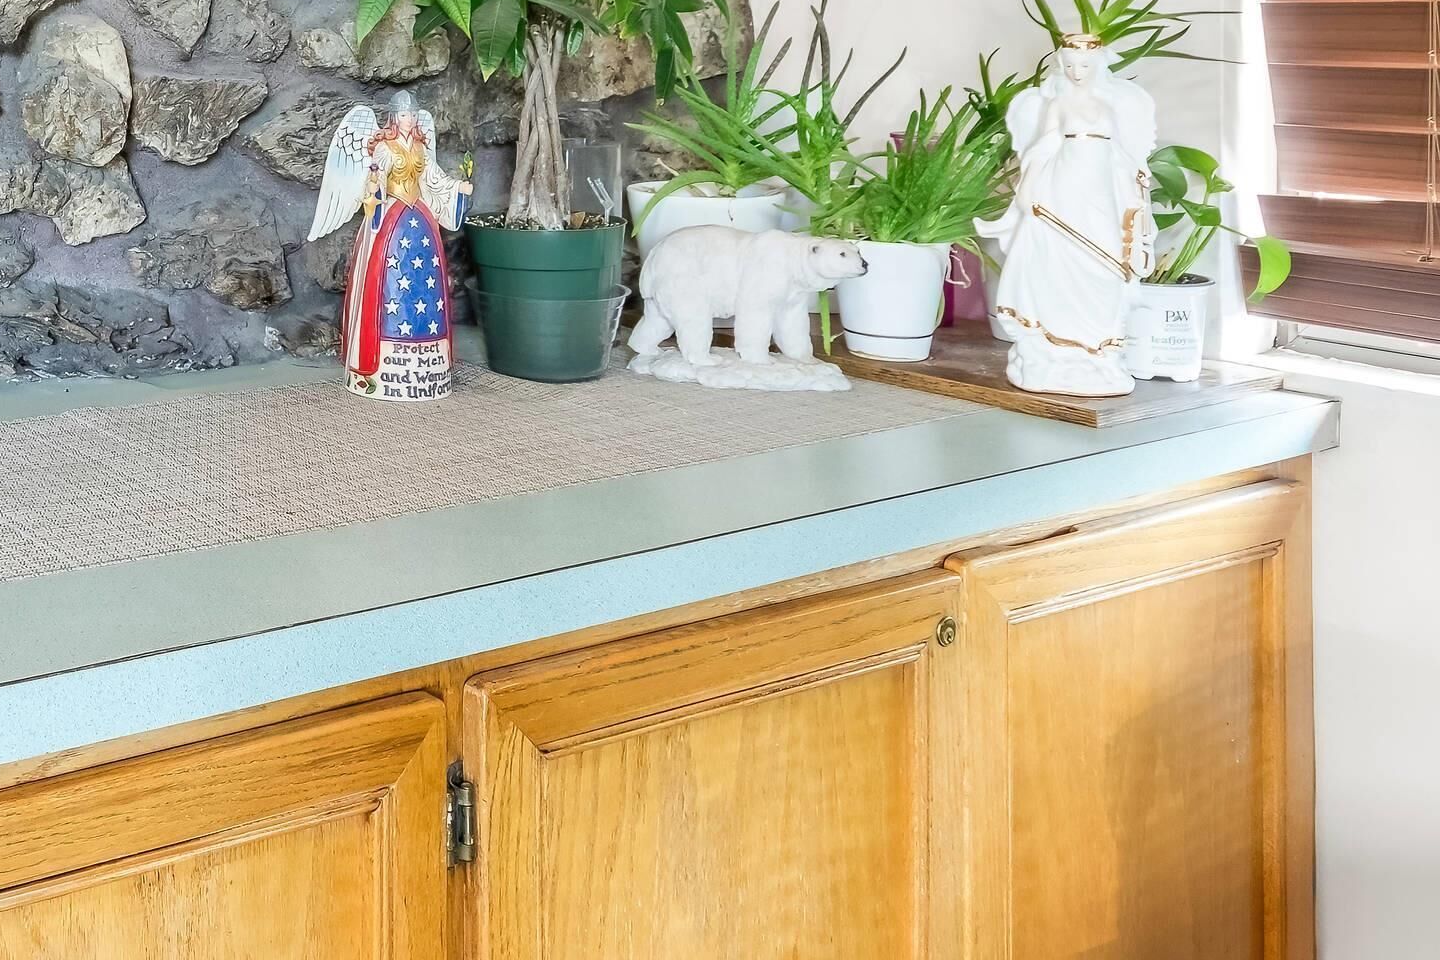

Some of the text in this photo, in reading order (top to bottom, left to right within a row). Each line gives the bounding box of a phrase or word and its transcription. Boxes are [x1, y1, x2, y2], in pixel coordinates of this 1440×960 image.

[392, 343, 440, 354] Protect
[383, 355, 445, 368] our Men
[380, 370, 412, 384] and
